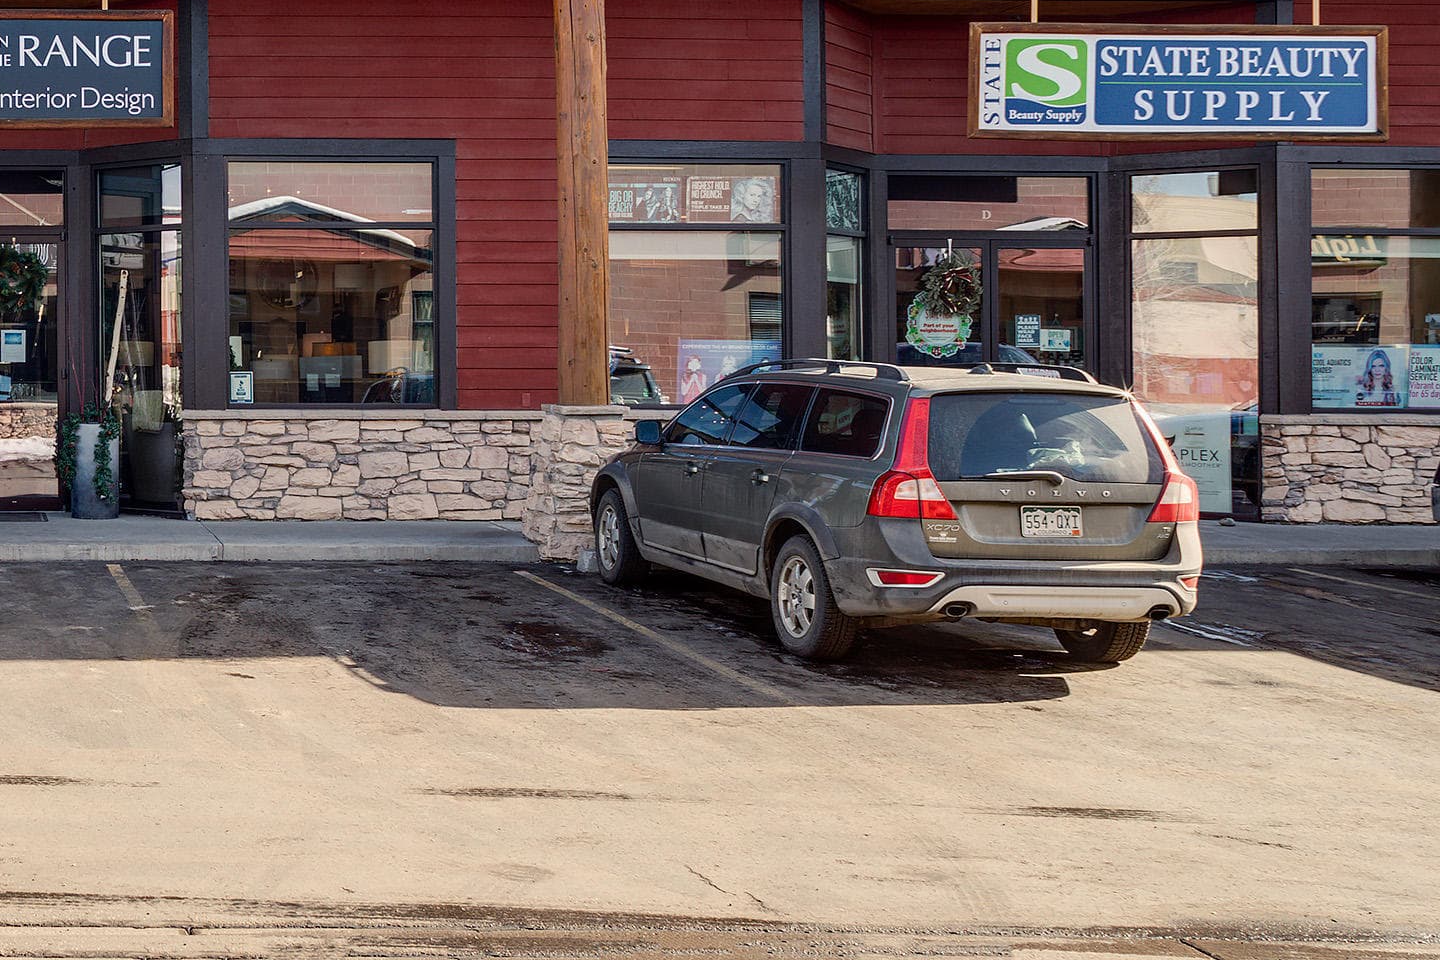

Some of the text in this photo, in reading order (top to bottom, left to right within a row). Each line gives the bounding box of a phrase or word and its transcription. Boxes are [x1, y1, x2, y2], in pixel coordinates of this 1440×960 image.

[18, 34, 152, 68] RANGE
[1100, 45, 1365, 78] STATE BEAUTY
[983, 38, 1001, 125] STATE
[1011, 43, 1082, 102] S
[80, 86, 155, 115] Design
[1134, 89, 1330, 121] SUPPLY
[1008, 109, 1083, 122] Beauty Supply
[982, 209, 992, 220] D
[1410, 356, 1433, 365] COLOR
[1409, 372, 1438, 381] SERVICE
[1000, 488, 1111, 498] VOLVO
[926, 523, 960, 532] XC70
